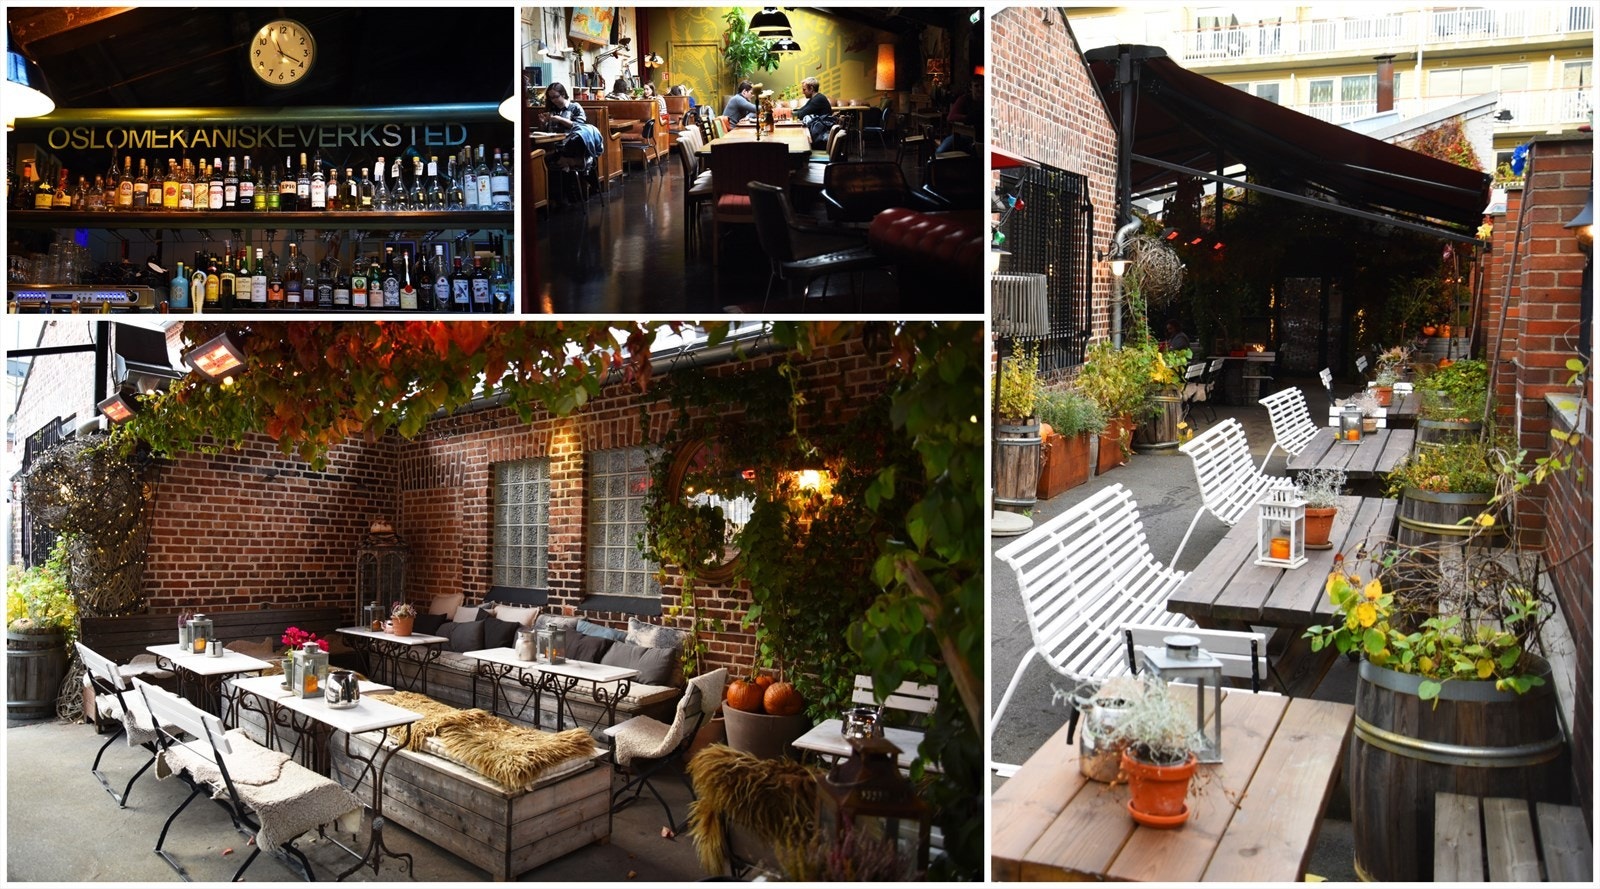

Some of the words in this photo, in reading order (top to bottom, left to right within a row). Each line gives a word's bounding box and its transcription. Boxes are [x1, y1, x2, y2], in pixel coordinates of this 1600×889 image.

[279, 26, 287, 34] 12
[259, 38, 267, 46] 10
[299, 37, 305, 45] 2
[255, 49, 261, 57] 9
[303, 49, 308, 57] 3
[268, 69, 274, 77] 7
[278, 72, 284, 80] 6
[290, 69, 296, 77] 5
